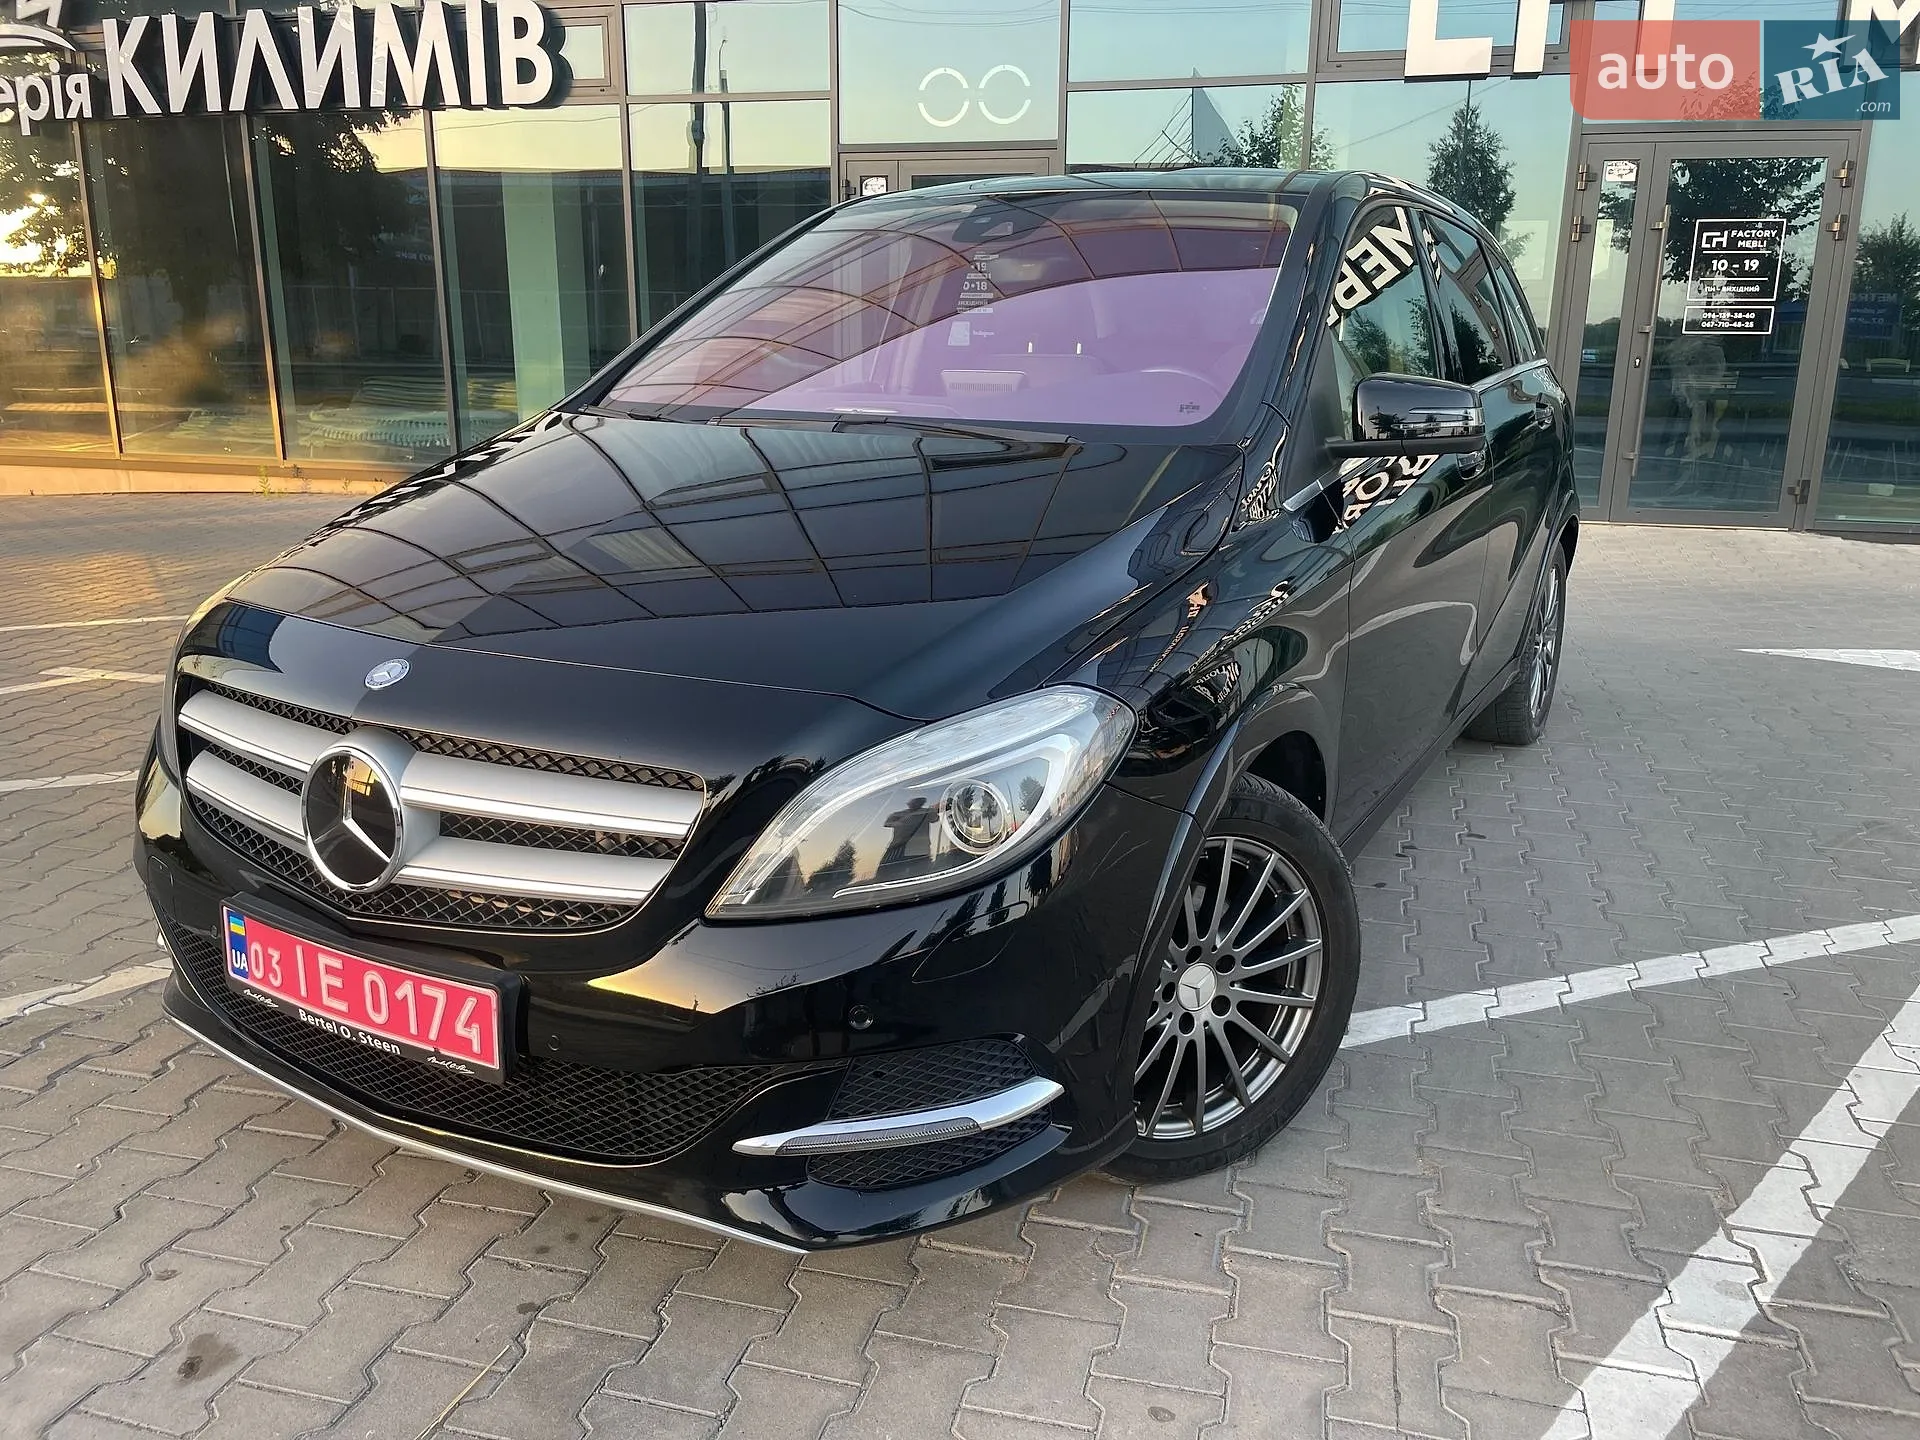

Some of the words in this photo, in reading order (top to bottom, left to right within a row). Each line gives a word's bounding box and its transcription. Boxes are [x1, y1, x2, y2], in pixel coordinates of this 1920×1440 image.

[102, 0, 555, 116] КИЛИМІВ
[1730, 229, 1778, 238] FACTORY
[1737, 239, 1767, 248] MEBLI
[1711, 259, 1729, 271] 10
[1743, 259, 1760, 271] 19
[232, 948, 249, 972] UA
[250, 941, 282, 988] 03
[295, 943, 350, 1014] IE
[362, 969, 481, 1055] 0174
[298, 1008, 338, 1034] Bertel
[358, 1031, 401, 1055] Steen
